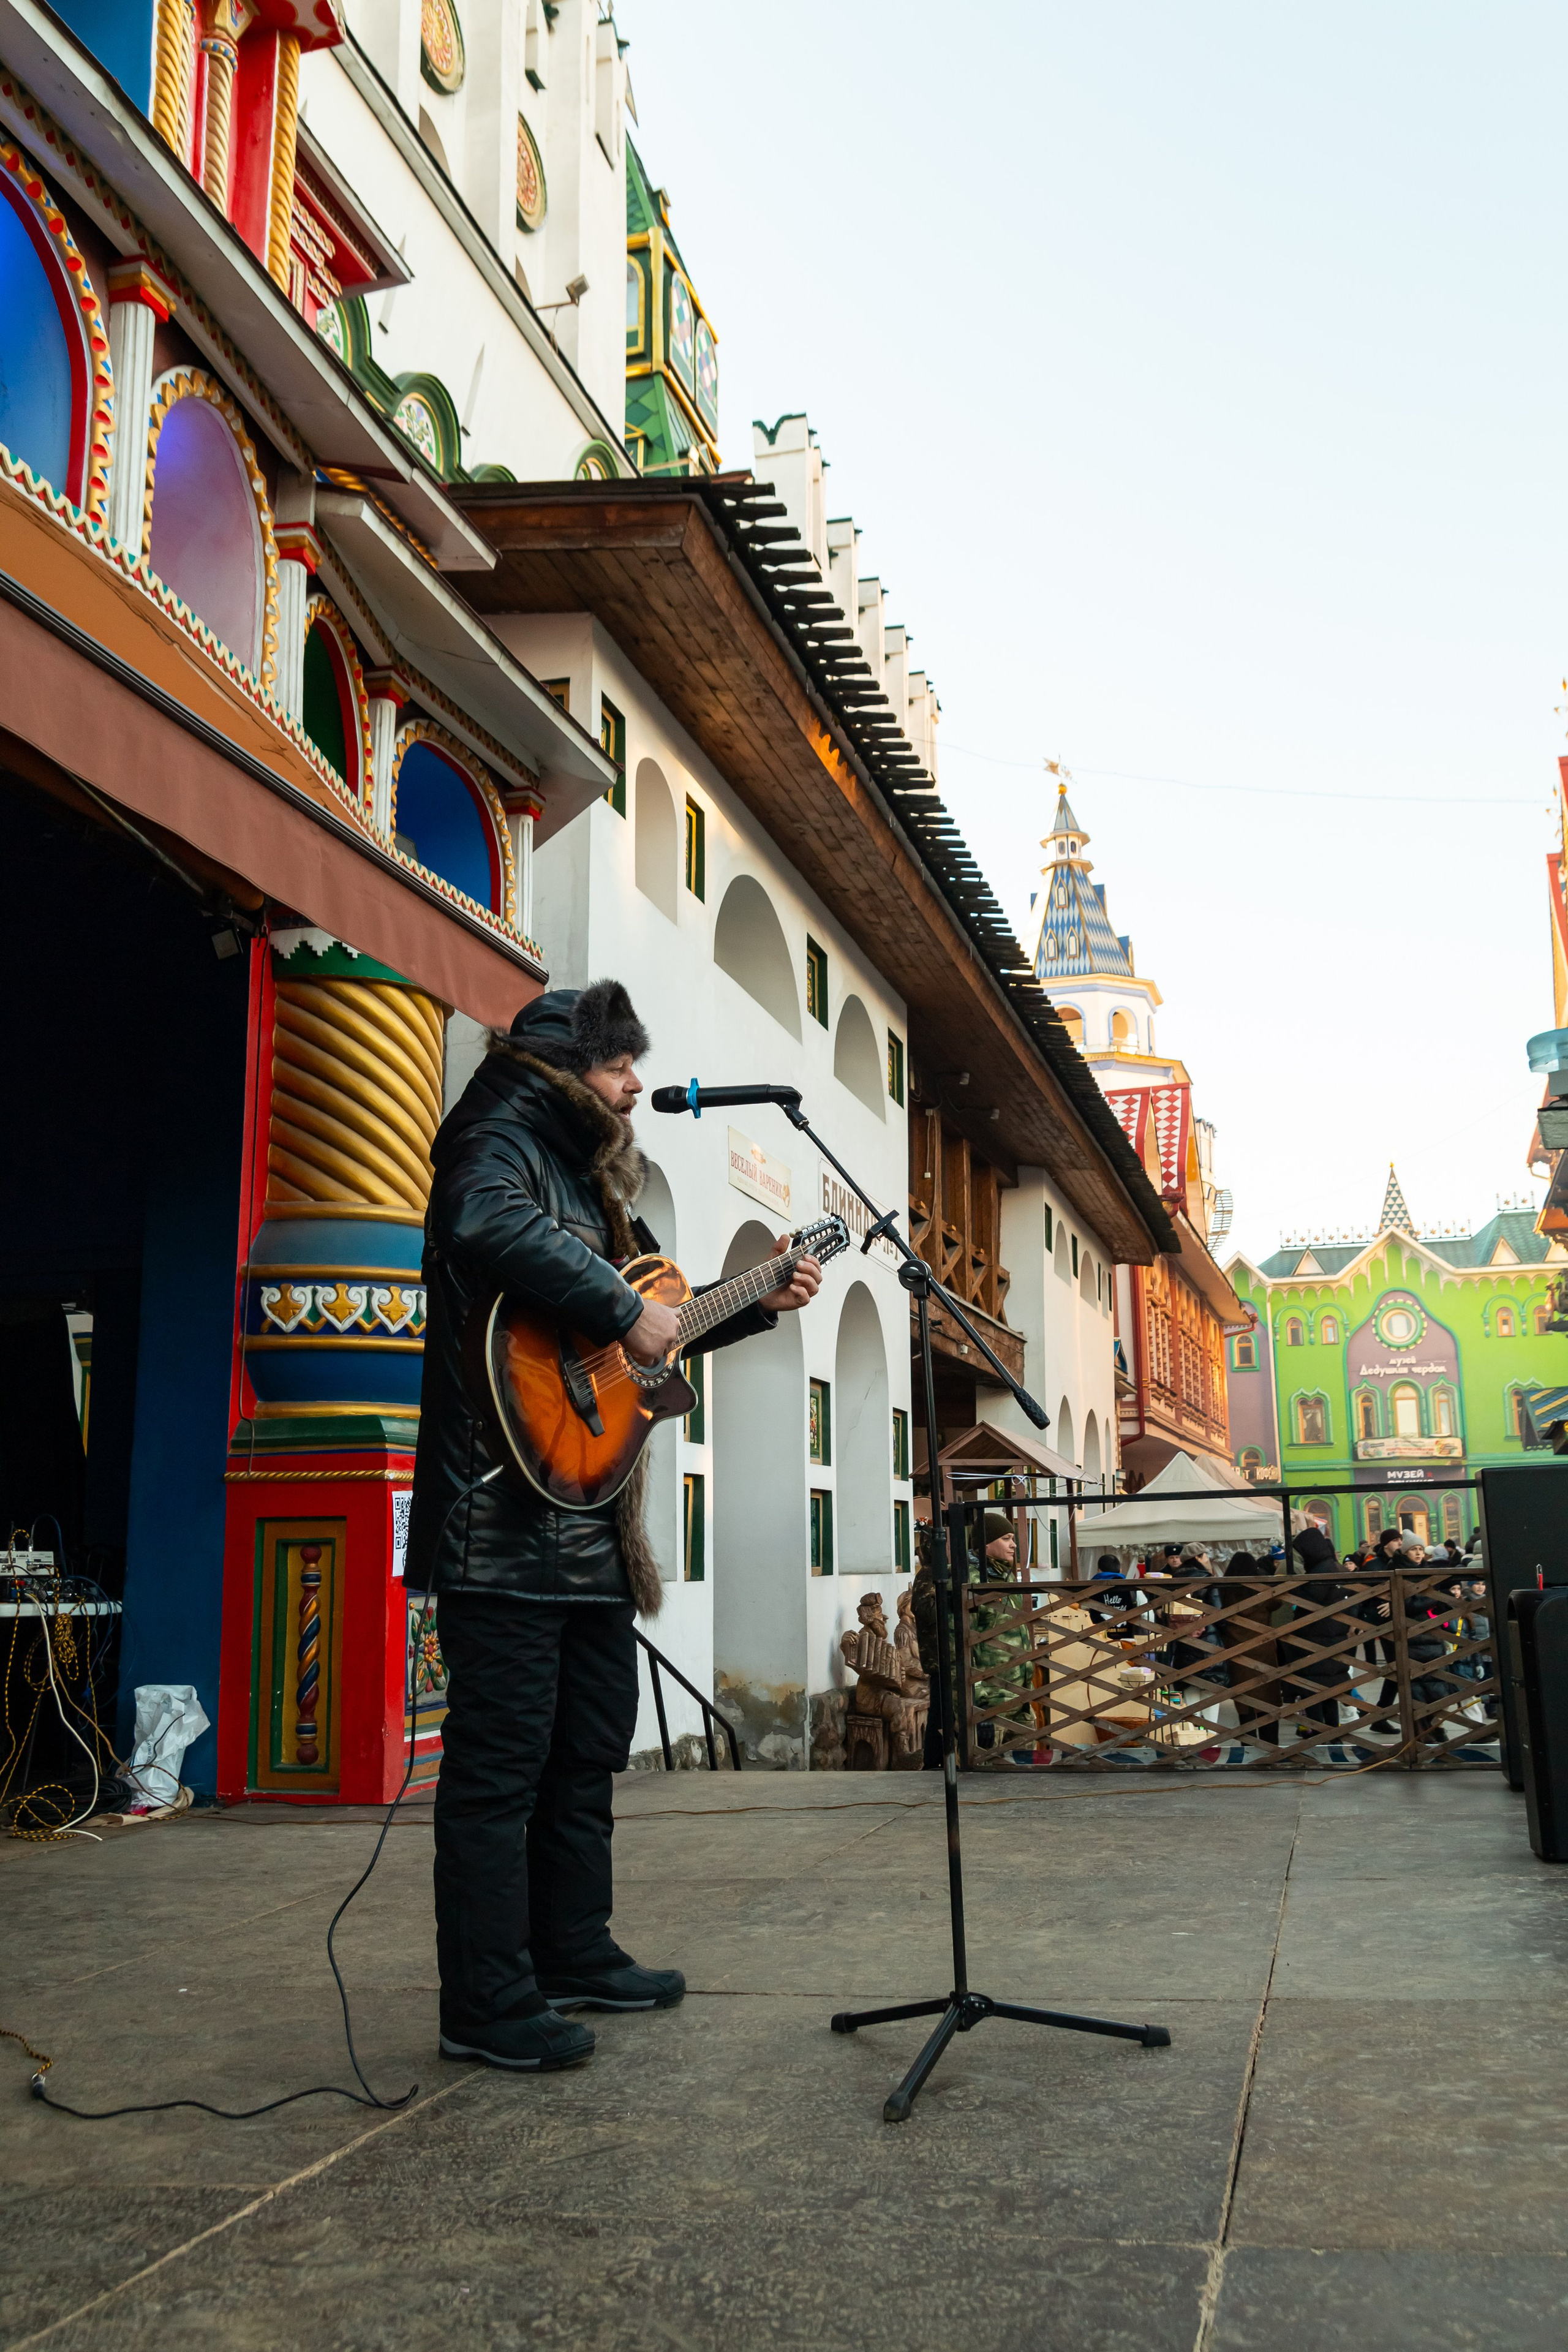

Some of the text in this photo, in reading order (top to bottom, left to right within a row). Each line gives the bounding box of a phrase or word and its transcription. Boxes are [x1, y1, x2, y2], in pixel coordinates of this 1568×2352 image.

[731, 1150, 757, 1182] ВЕСЕЛЫЙ
[759, 1169, 782, 1199] ВАРЕНИК
[1411, 1362, 1447, 1376] чердак
[1387, 1469, 1424, 1479] МУЗЕЙ
[1103, 1594, 1122, 1605] Hello
